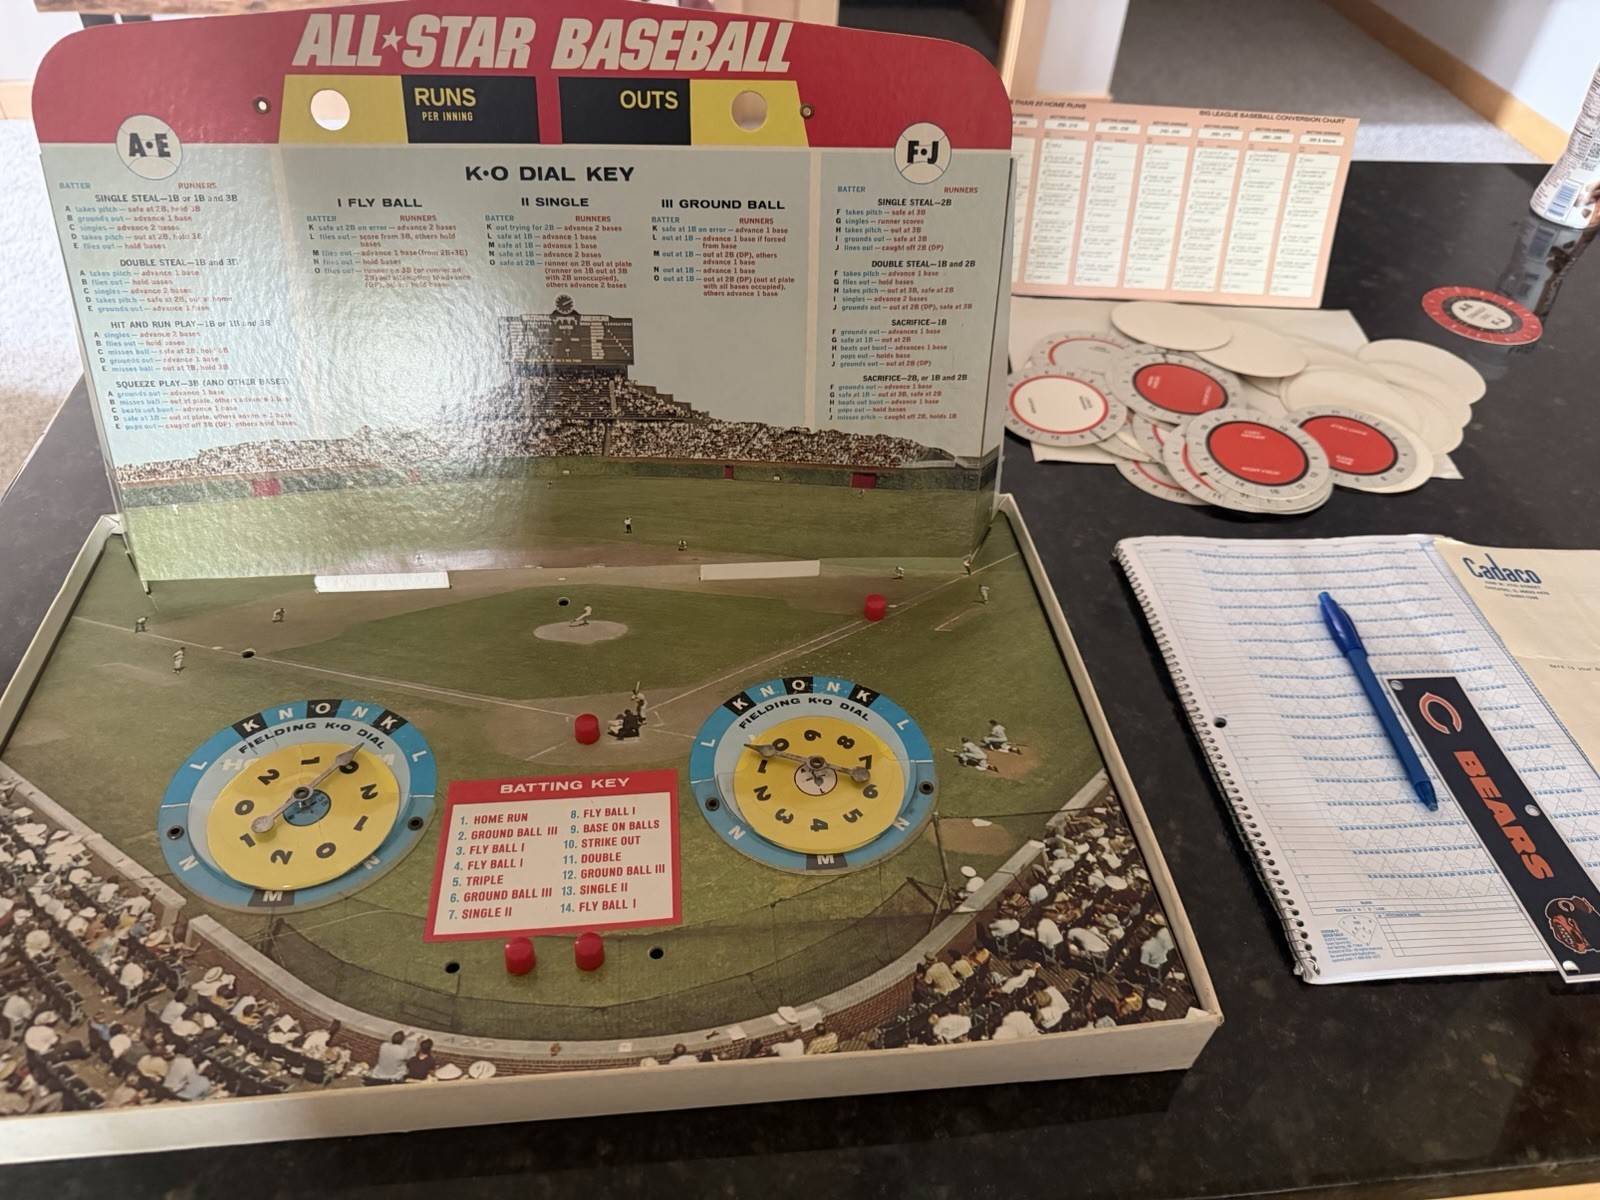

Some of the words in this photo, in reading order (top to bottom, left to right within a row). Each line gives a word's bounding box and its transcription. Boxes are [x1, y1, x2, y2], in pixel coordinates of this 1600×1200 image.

[292, 14, 380, 66] ALL
[402, 14, 536, 68] STAR
[551, 18, 794, 73] BASEBALL
[414, 88, 476, 107] RUNS
[620, 91, 678, 109] OUTS
[422, 111, 438, 121] PER
[442, 111, 473, 122] INNING
[520, 167, 575, 182] DIAL
[587, 167, 634, 182] KEY
[194, 194, 205, 202] 1B
[337, 198, 341, 207] I
[348, 198, 375, 207] FLY
[383, 199, 422, 207] BALL
[521, 198, 529, 206] II
[536, 197, 589, 206] SINGLE
[662, 200, 672, 208] III
[679, 200, 741, 209] GROUND
[748, 201, 785, 209] BALL
[202, 379, 224, 387] (AND
[1463, 553, 1542, 584] Cadaco
[760, 686, 774, 697] N
[827, 682, 840, 692] N
[856, 691, 870, 701] K
[732, 698, 748, 710] K
[279, 708, 293, 719] N
[352, 707, 369, 718] N
[739, 697, 801, 729] FIELDING
[840, 702, 869, 721] DIAL
[243, 719, 260, 732] K
[380, 716, 397, 729] K
[897, 720, 911, 730] L
[239, 722, 317, 754] FIELDING
[357, 730, 384, 749] DIAL
[701, 739, 716, 747] L
[837, 735, 855, 749] 8
[412, 750, 426, 762] L
[190, 761, 208, 770] L
[758, 760, 767, 774] 1
[500, 780, 582, 794] BATTING
[591, 778, 630, 788] KEY
[754, 785, 771, 801] 2
[460, 816, 468, 825] 1.
[474, 815, 503, 825] HOME
[507, 813, 528, 822] RUN
[570, 810, 579, 819] 8.
[584, 809, 601, 818] FLY
[605, 808, 629, 816] BALL
[632, 807, 635, 815] I
[775, 809, 794, 824] 3
[843, 809, 863, 823] 5
[1454, 750, 1554, 880] BEARS
[570, 825, 579, 834] 9.
[583, 823, 608, 833] BASE
[612, 822, 625, 831] ON
[629, 820, 660, 829] BALLS
[810, 818, 828, 832] 4
[458, 831, 466, 840] 2.
[471, 829, 513, 840] GROUND
[517, 828, 542, 837] BALL
[547, 826, 558, 835] III
[728, 825, 746, 841] N
[564, 840, 577, 849] 10.
[581, 838, 617, 848] STRIKE
[621, 836, 640, 845] OUT
[456, 846, 465, 856] 3.
[469, 845, 488, 854] FLY
[492, 844, 517, 853] BALL
[521, 843, 525, 852] I
[179, 856, 198, 871] N
[454, 862, 463, 871] 4.
[467, 860, 486, 870] FLY
[490, 859, 516, 869] BALL
[520, 859, 523, 867] I
[563, 855, 577, 864] 11.
[581, 853, 621, 863] DOUBLE
[563, 870, 576, 879] 12.
[581, 868, 623, 878] GROUND
[627, 866, 651, 875] BALL
[655, 864, 665, 873] III
[452, 877, 461, 887] 5.
[466, 875, 504, 886] TRIPLE
[450, 893, 459, 903] 6.
[463, 891, 507, 902] GROUND
[512, 890, 537, 899] BALL
[542, 888, 552, 897] III
[561, 886, 575, 896] 13.
[580, 883, 617, 894] SINGLE
[621, 883, 628, 892] II
[560, 903, 574, 913] 14.
[579, 902, 598, 912] FLY
[602, 901, 628, 910] BALL
[633, 899, 636, 908] I
[449, 910, 457, 919] 7.
[462, 908, 501, 919] SINGLE
[505, 907, 512, 917] II
